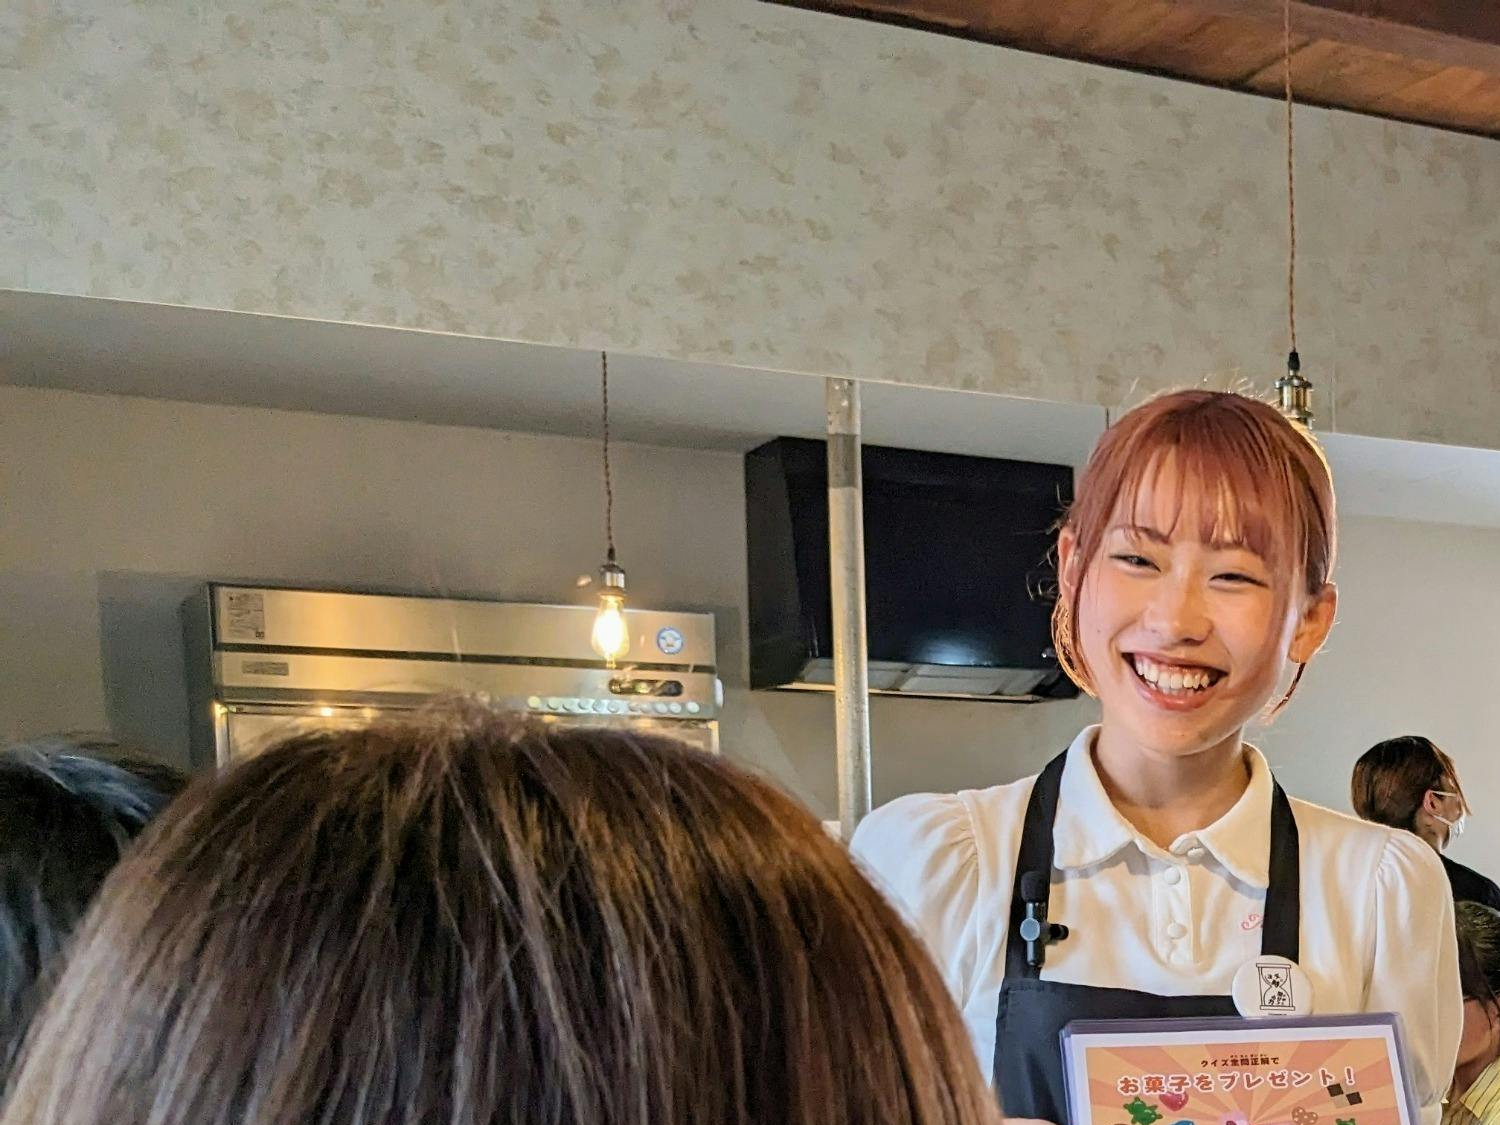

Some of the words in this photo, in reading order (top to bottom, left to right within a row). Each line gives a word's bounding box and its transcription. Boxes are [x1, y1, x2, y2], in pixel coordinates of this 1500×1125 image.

[1118, 1067, 1356, 1096] お菓子をプレゼント！
